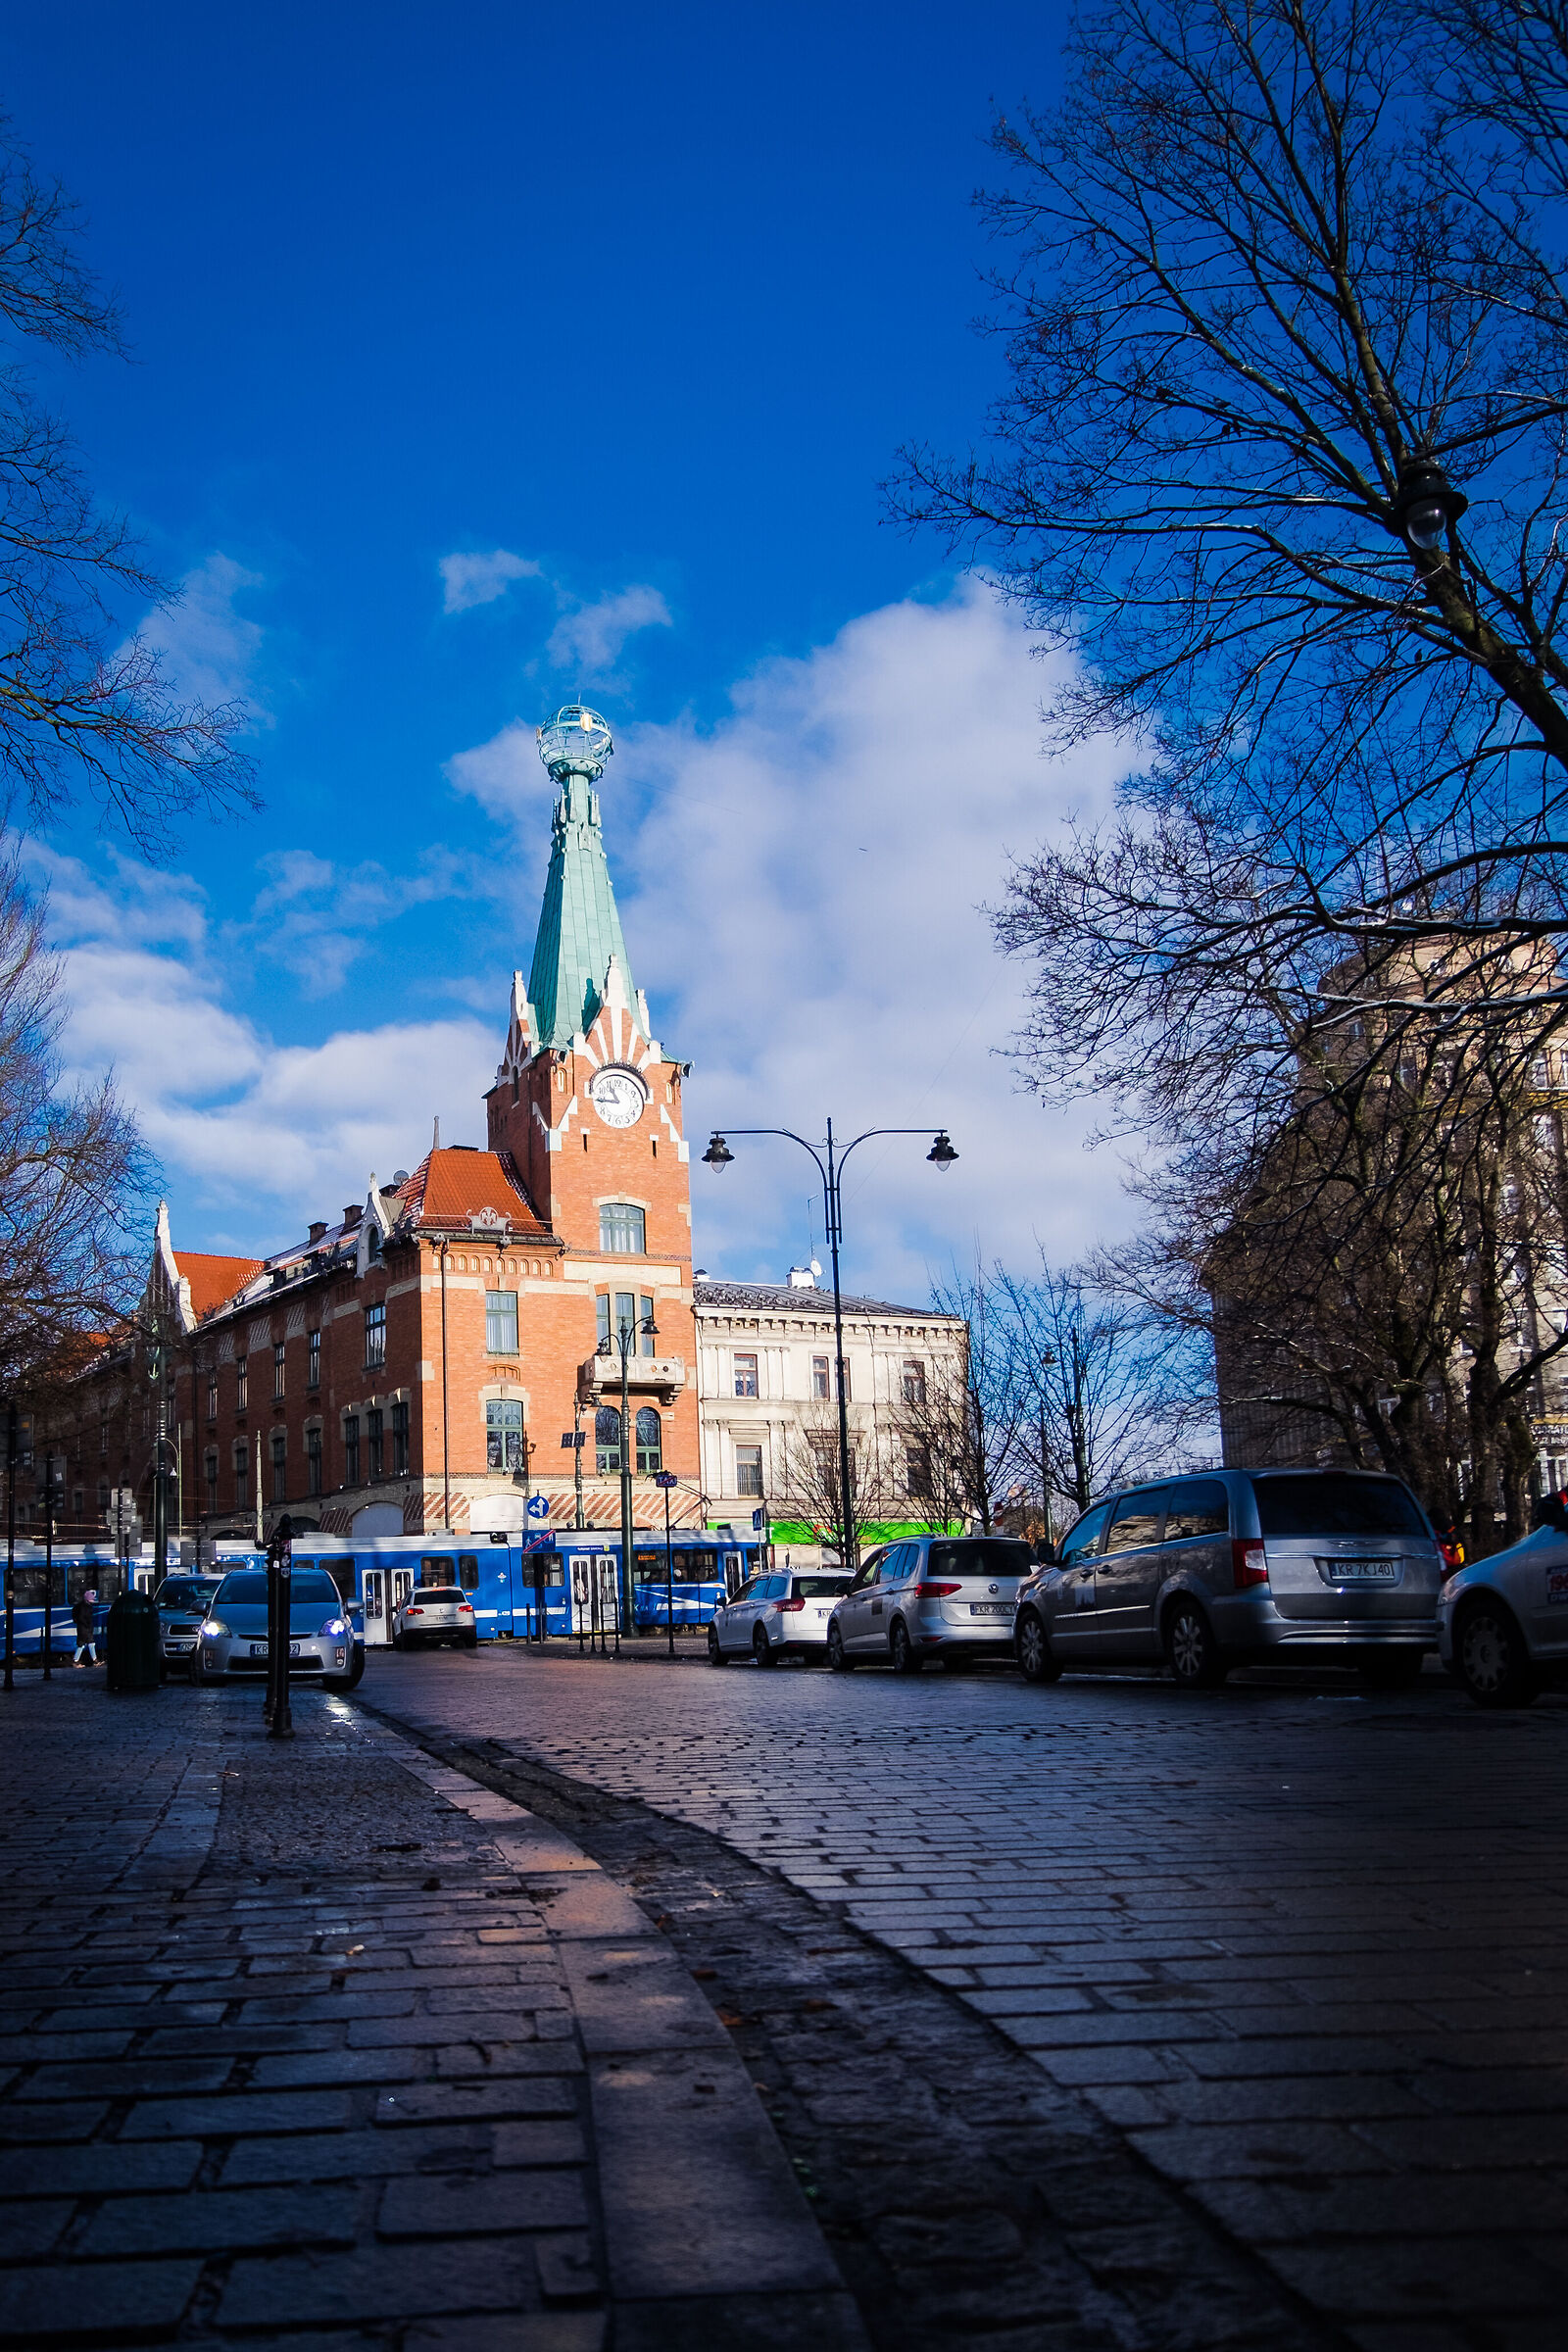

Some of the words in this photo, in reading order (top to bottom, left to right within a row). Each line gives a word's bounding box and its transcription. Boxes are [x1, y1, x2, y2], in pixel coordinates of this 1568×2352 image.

[614, 1079, 622, 1088] 12
[600, 1106, 606, 1115] 8
[1339, 1563, 1353, 1576] KR
